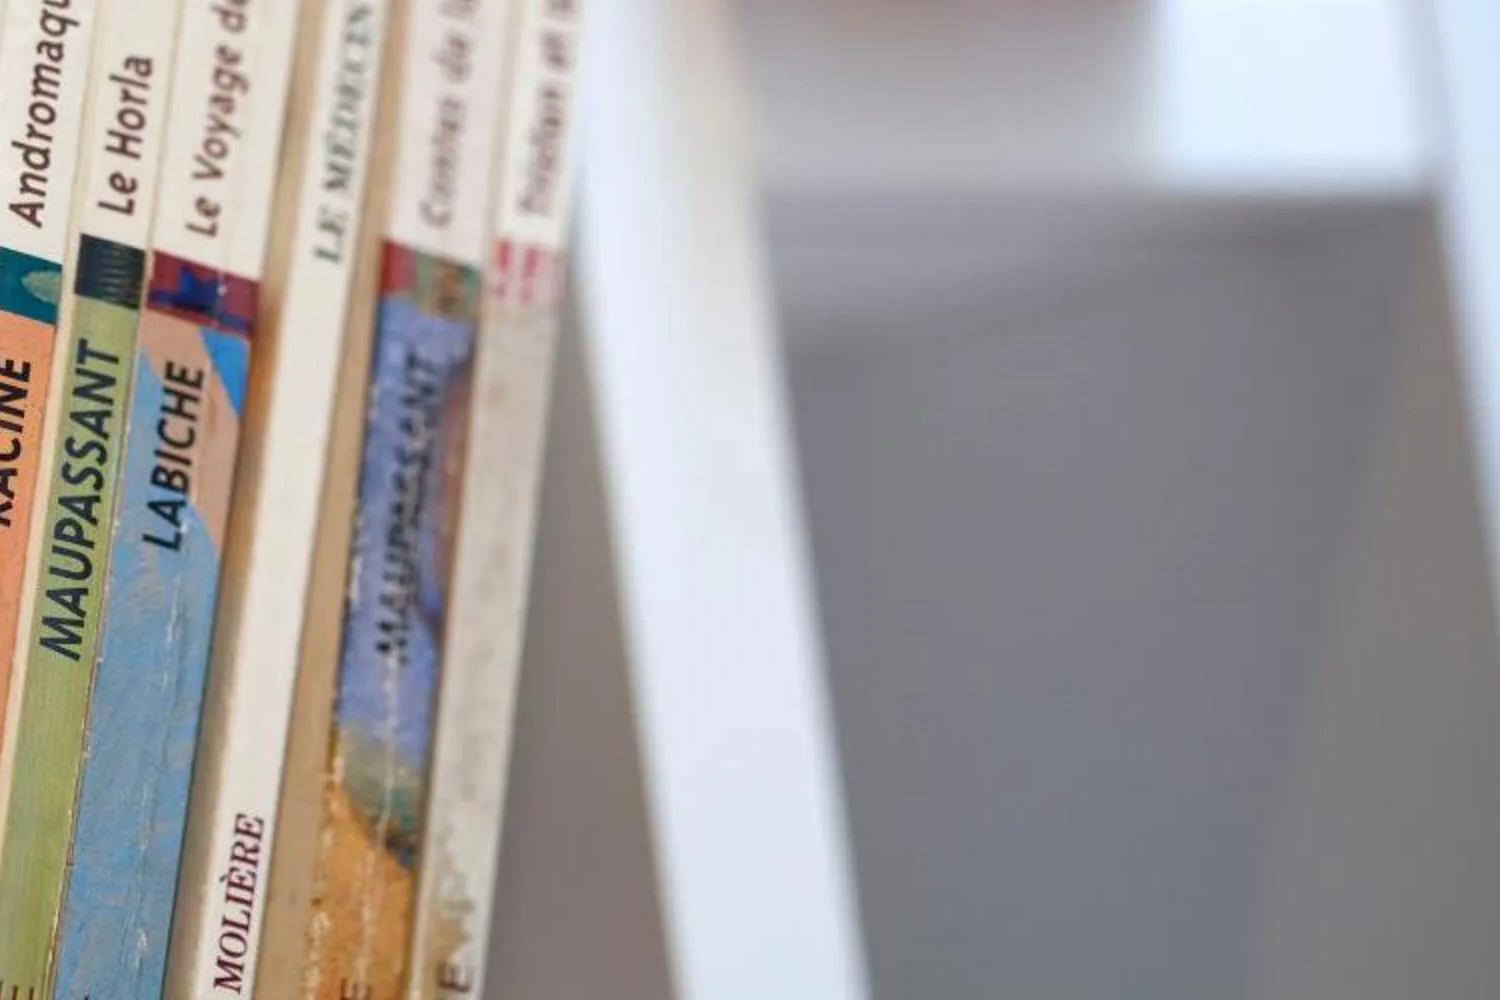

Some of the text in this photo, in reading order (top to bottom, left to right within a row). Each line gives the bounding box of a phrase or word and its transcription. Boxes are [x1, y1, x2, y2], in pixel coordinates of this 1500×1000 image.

[97, 53, 155, 216] Le Horla
[191, 42, 251, 182] Voyage
[186, 195, 223, 240] Le
[311, 202, 349, 266] LE
[38, 337, 122, 663] MAUPASSANT
[143, 360, 206, 553] LABICHE
[213, 812, 265, 995] MOLIÈRE
